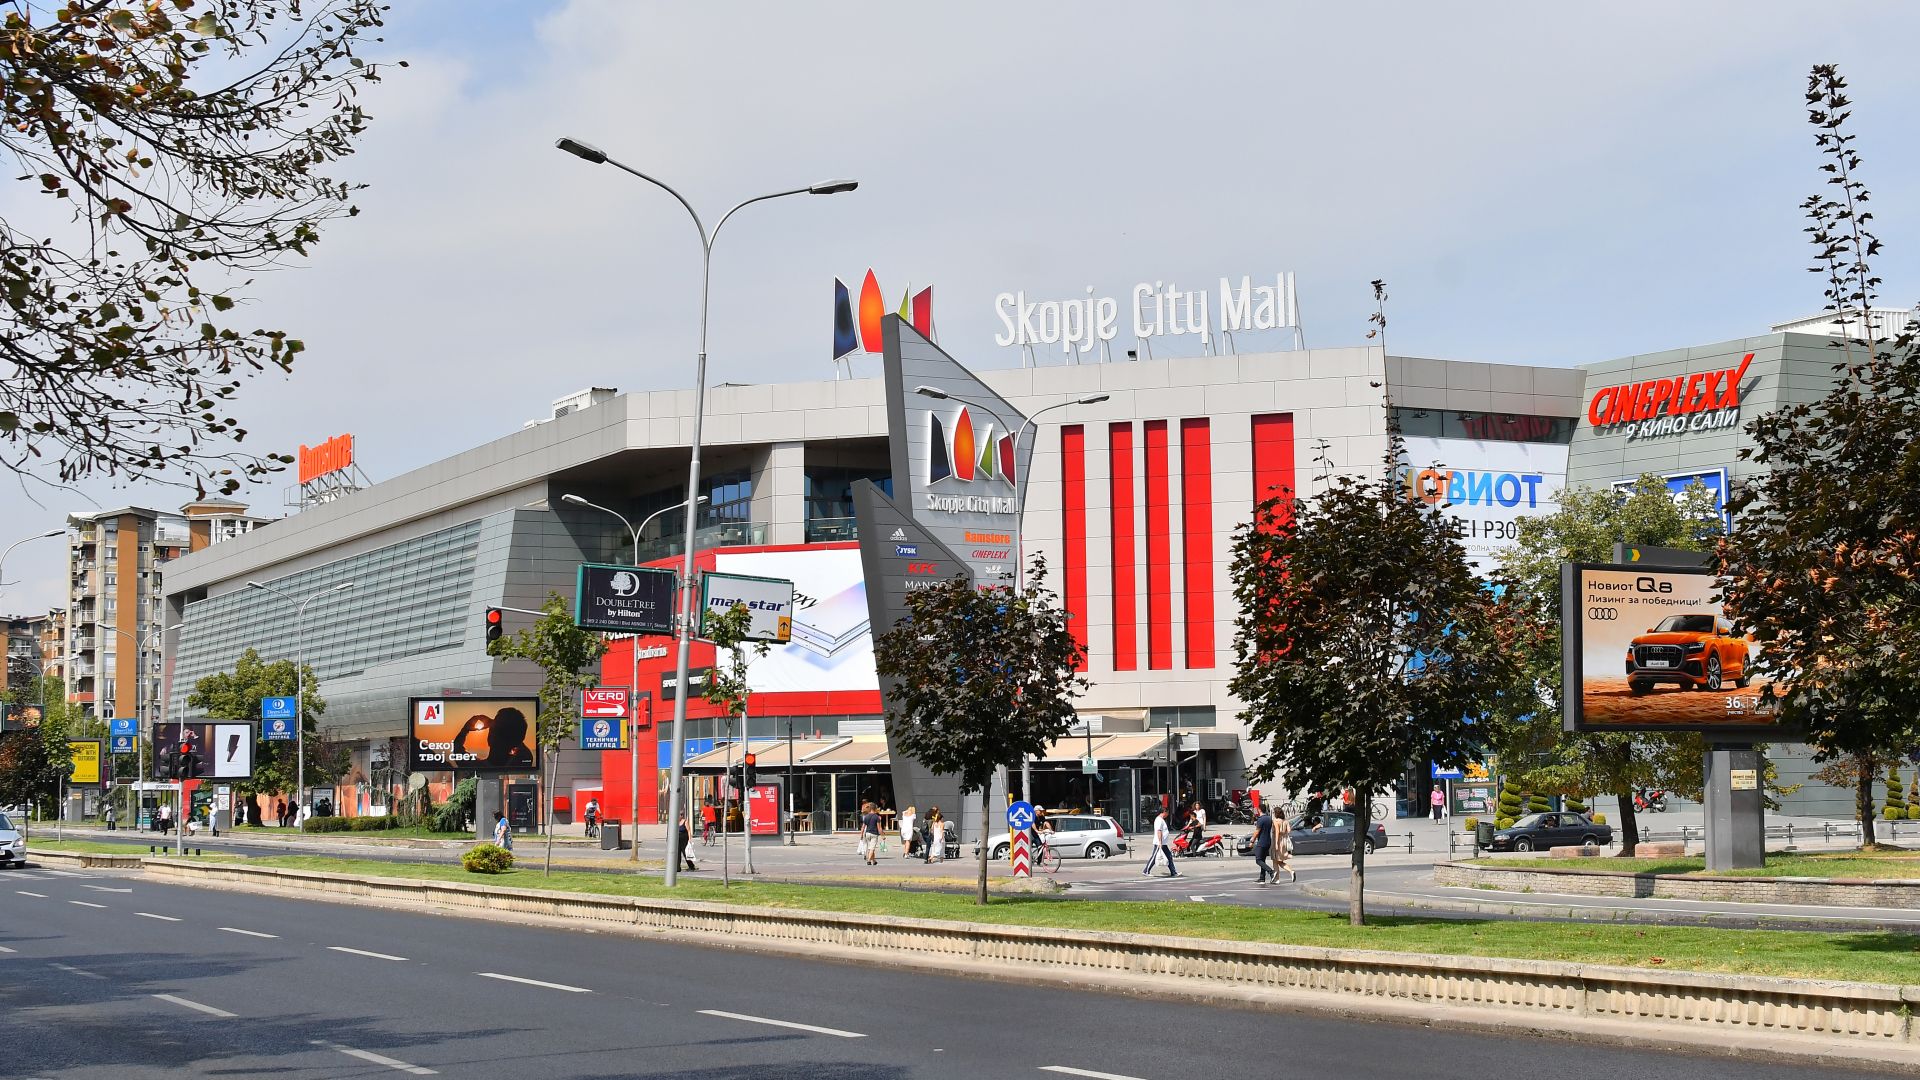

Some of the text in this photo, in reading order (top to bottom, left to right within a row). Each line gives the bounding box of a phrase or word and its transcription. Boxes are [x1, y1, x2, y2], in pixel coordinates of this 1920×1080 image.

[995, 271, 1296, 353] Skopje City Mall
[1588, 353, 1755, 426] CINEPLEXX
[1626, 409, 1738, 439] 9 КИНО САЛИ
[927, 494, 1015, 515] Skopje City Mall
[1484, 520, 1516, 540] P30
[965, 531, 1010, 544] Ramstore
[971, 549, 1010, 559] CINEPLEXX
[908, 562, 938, 574] KFC
[1588, 577, 1673, 593] Новиот Q8
[1587, 594, 1626, 604] Лизинг
[1642, 596, 1701, 607] победници!
[607, 608, 617, 617] by
[588, 692, 624, 701] VERO
[424, 703, 440, 720] A1
[419, 739, 455, 753] Секој
[418, 752, 477, 763] твој свет
